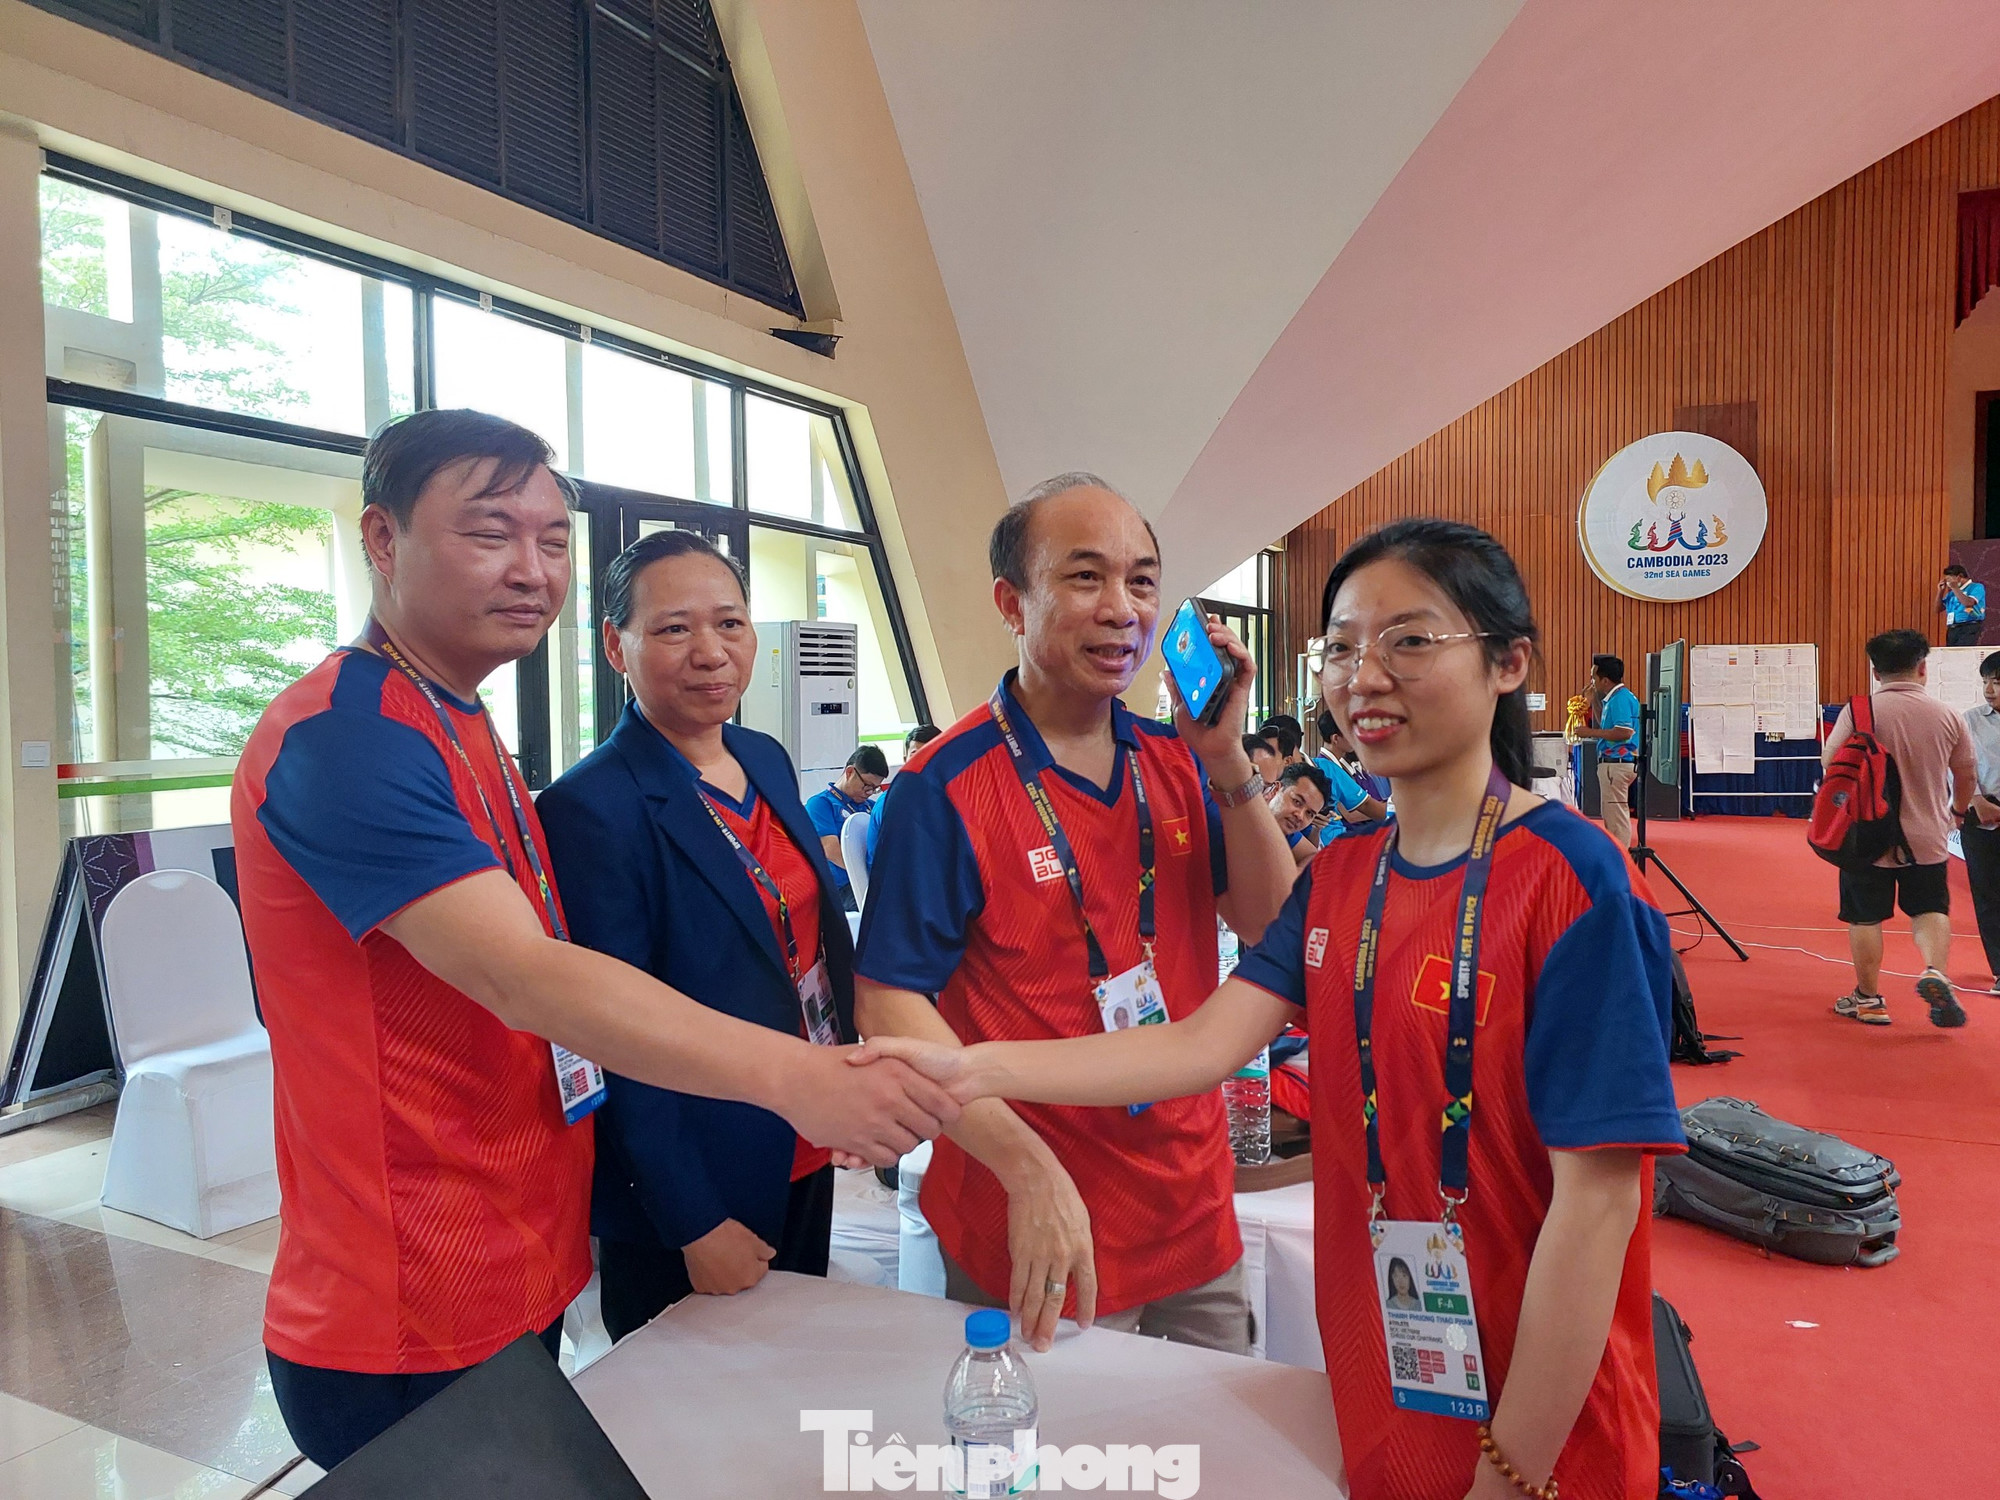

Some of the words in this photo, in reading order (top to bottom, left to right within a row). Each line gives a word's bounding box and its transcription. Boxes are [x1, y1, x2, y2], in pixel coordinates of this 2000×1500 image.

[1627, 555, 1693, 568] CAMBODIA
[1697, 554, 1728, 566] 2023
[1666, 570, 1680, 578] SEA
[1682, 569, 1711, 578] GAMES
[1025, 781, 1039, 800] 2023
[1033, 799, 1056, 836] CAMBODIA
[721, 827, 741, 849] SPORTS
[1034, 849, 1058, 865] JG
[1035, 864, 1062, 878] BL
[1450, 1401, 1484, 1417] 123R
